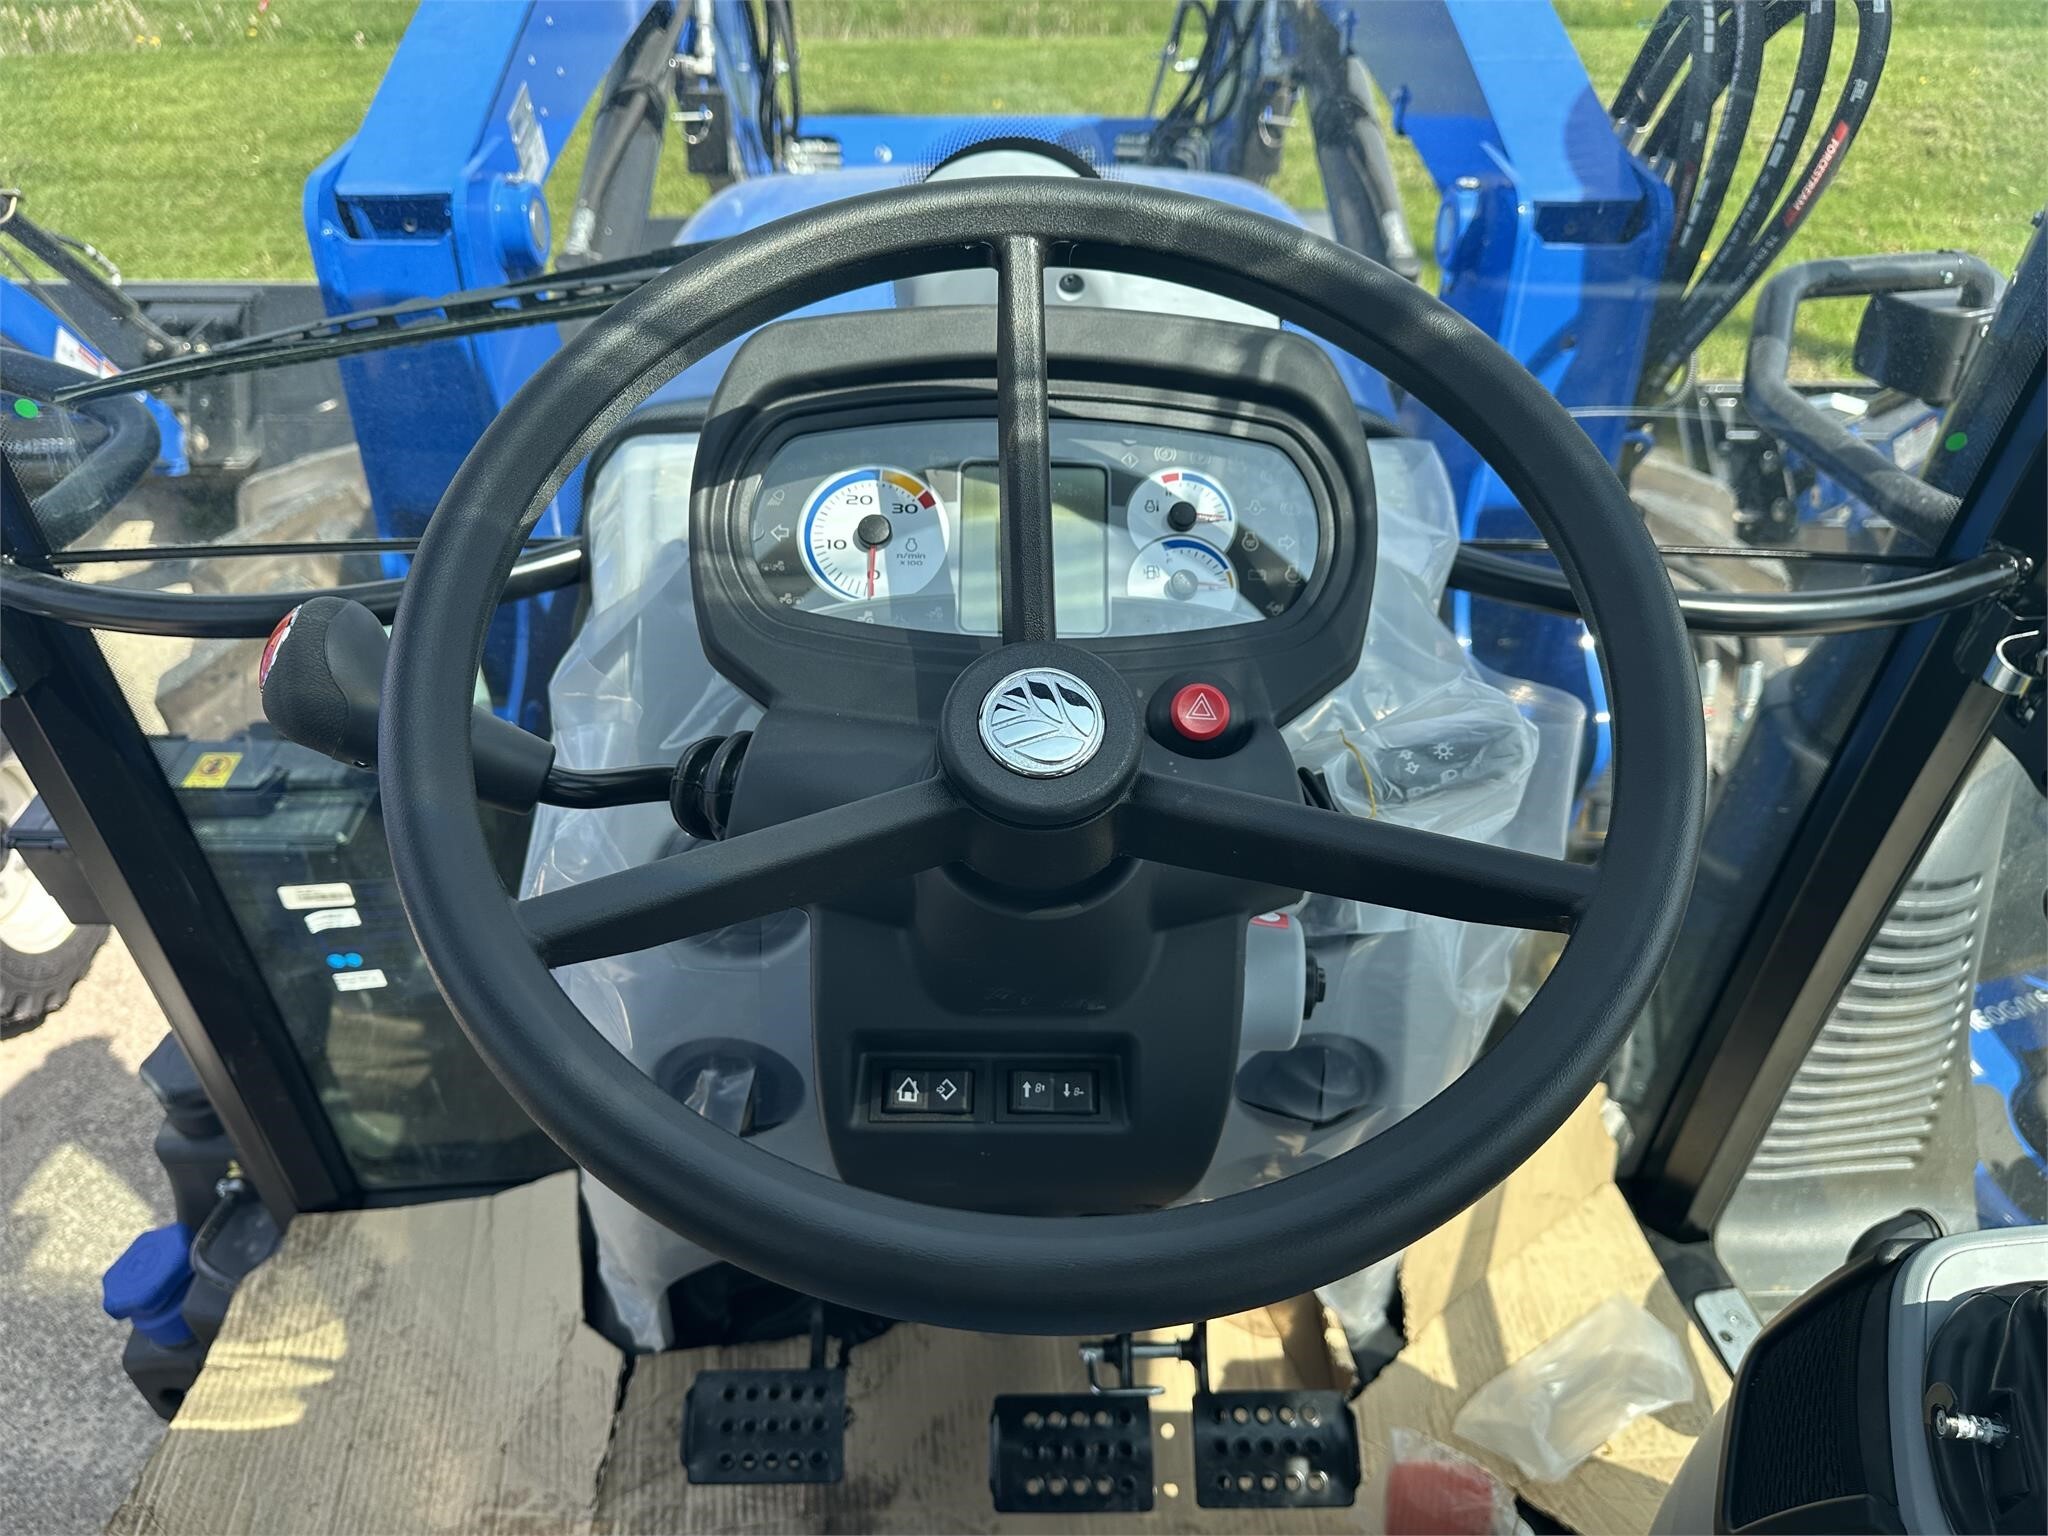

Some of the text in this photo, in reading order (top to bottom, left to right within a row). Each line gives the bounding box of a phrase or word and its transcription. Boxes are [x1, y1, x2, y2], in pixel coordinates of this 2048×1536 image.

[846, 494, 873, 506] 20
[891, 503, 918, 515] 30
[826, 538, 847, 550] 10
